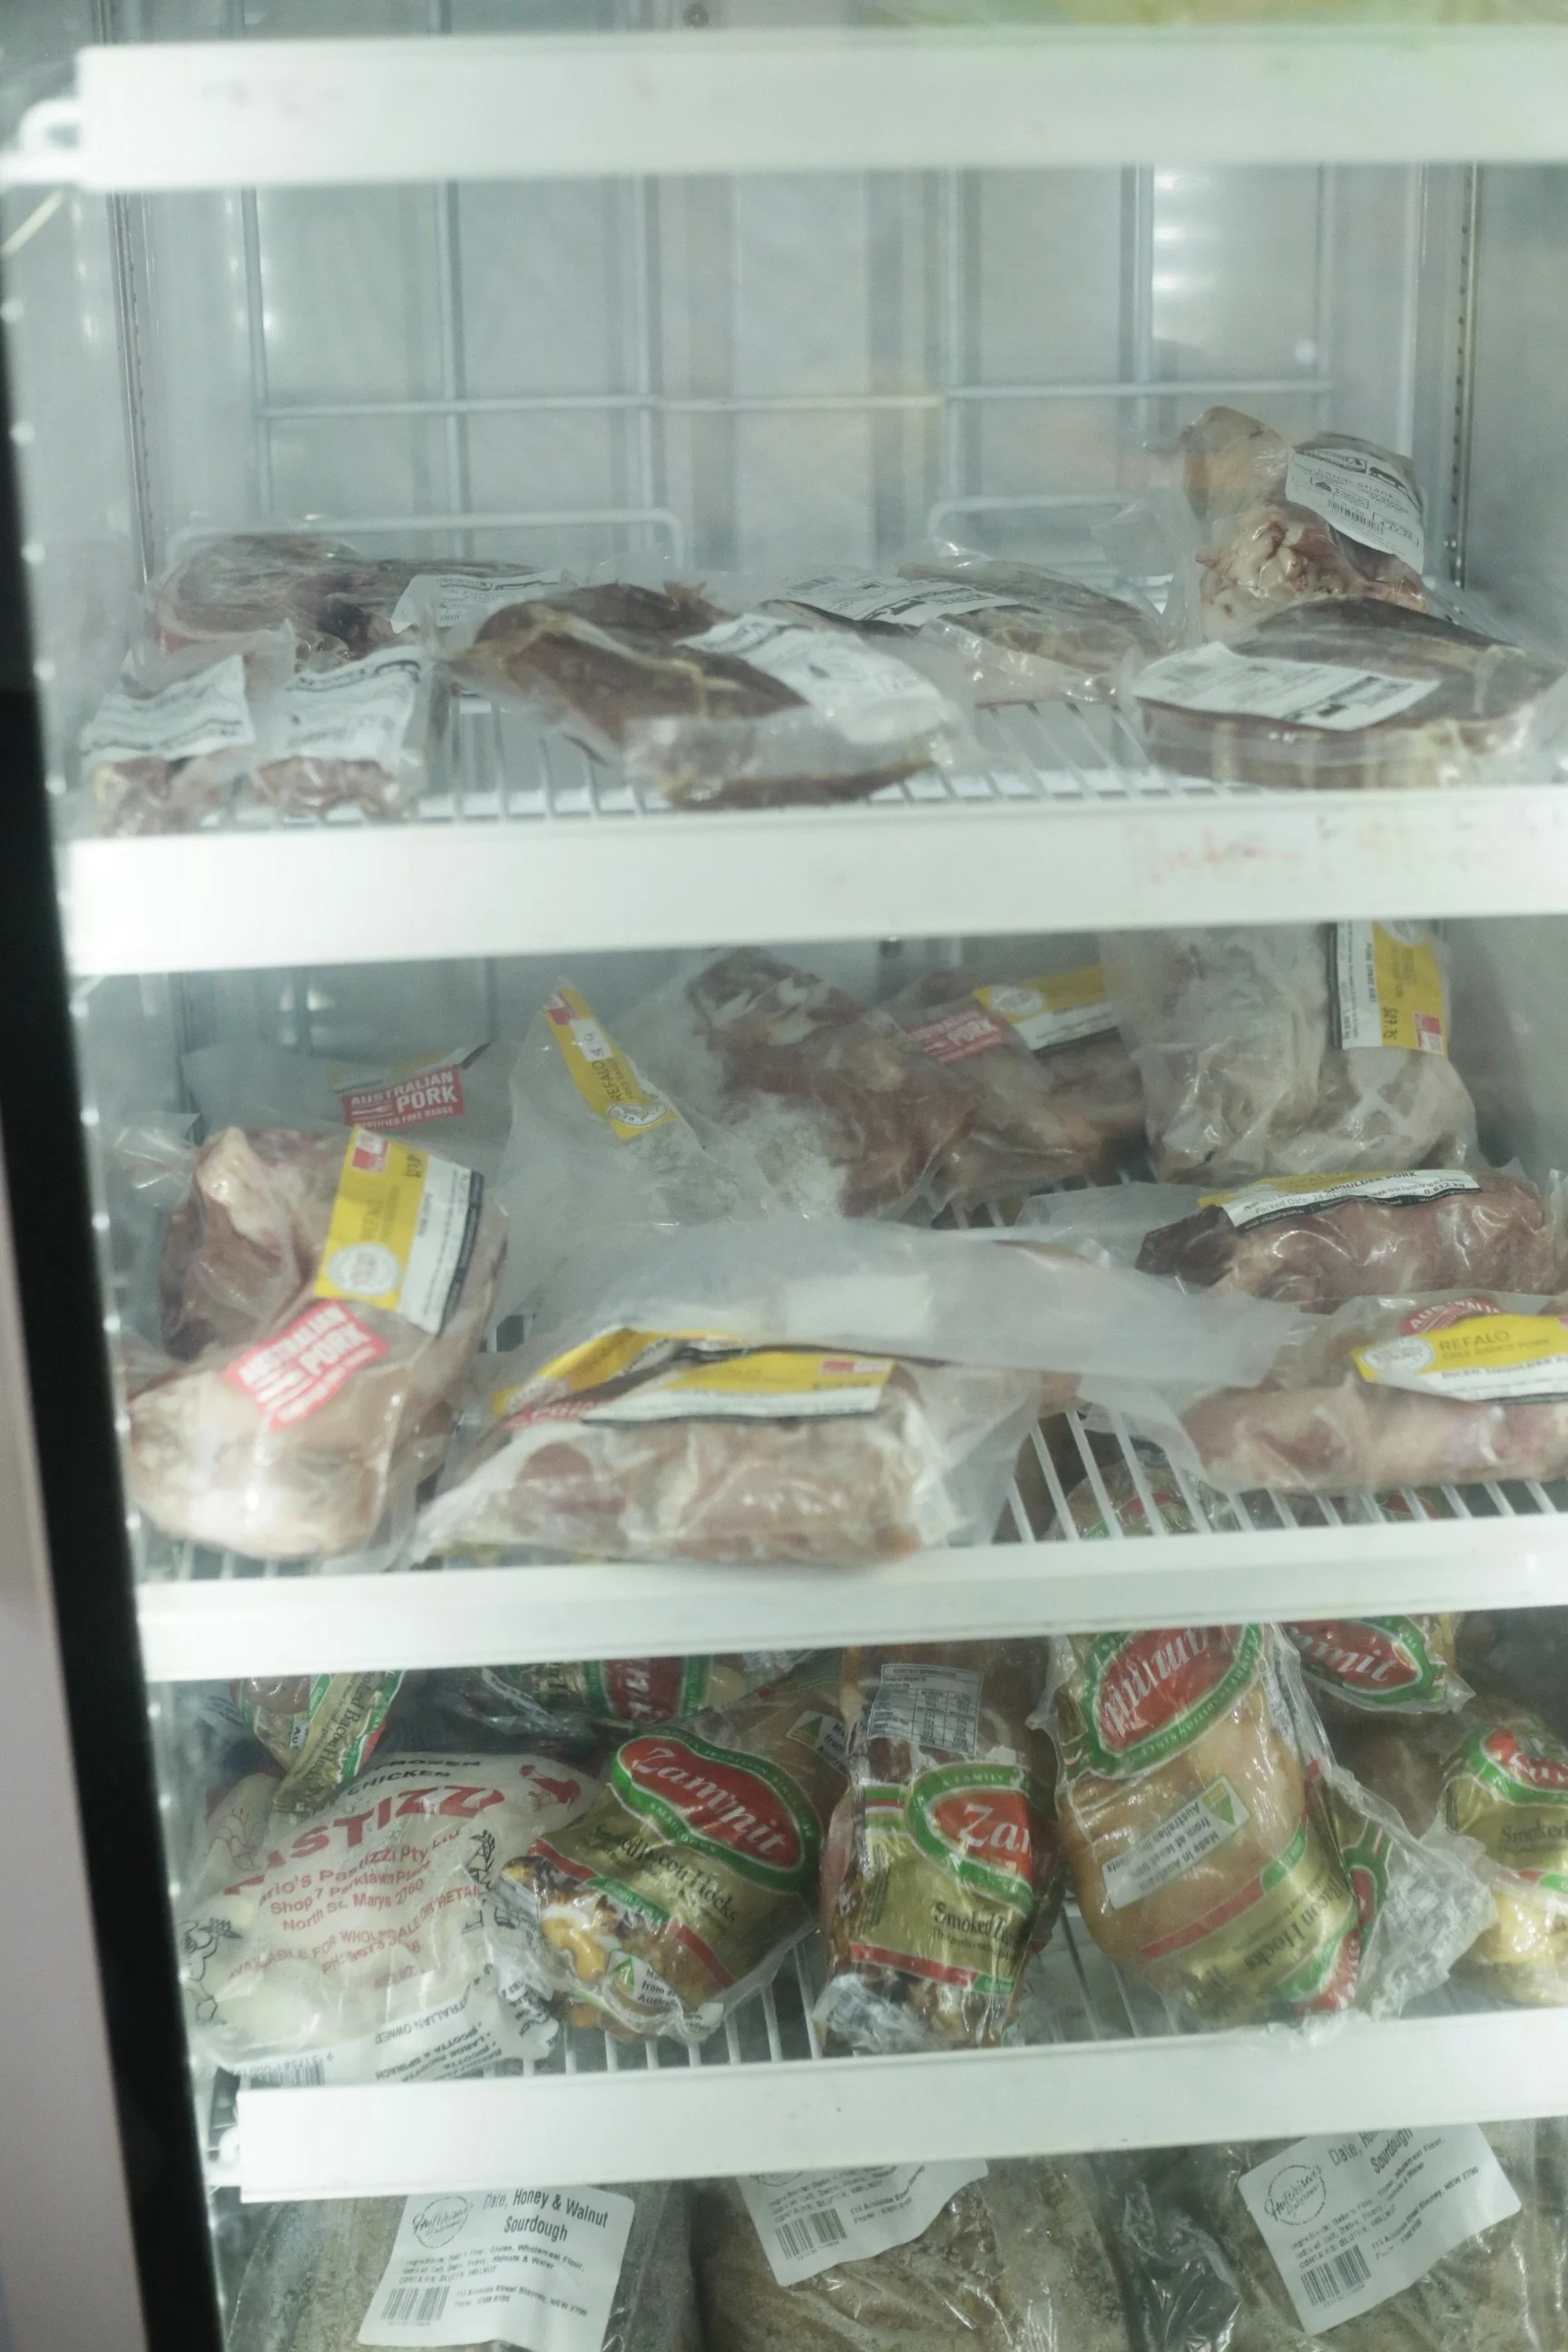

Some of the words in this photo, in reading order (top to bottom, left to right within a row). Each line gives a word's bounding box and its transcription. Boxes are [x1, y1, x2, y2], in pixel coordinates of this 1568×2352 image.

[592, 1060, 623, 1102] REFALO
[397, 1083, 459, 1113] PORK
[1438, 1330, 1510, 1351] REFALO
[348, 1769, 451, 1796] CHICKEN
[632, 1745, 787, 1856] Zammit
[270, 1896, 313, 1916] Shop
[282, 1907, 325, 1932] North
[352, 1892, 392, 1911] Marys
[1328, 2142, 1363, 2167] Date,
[512, 2188, 550, 2210] Honey
[552, 2193, 563, 2210] &
[565, 2198, 610, 2229] Walnut
[504, 2214, 570, 2244] Sourdough
